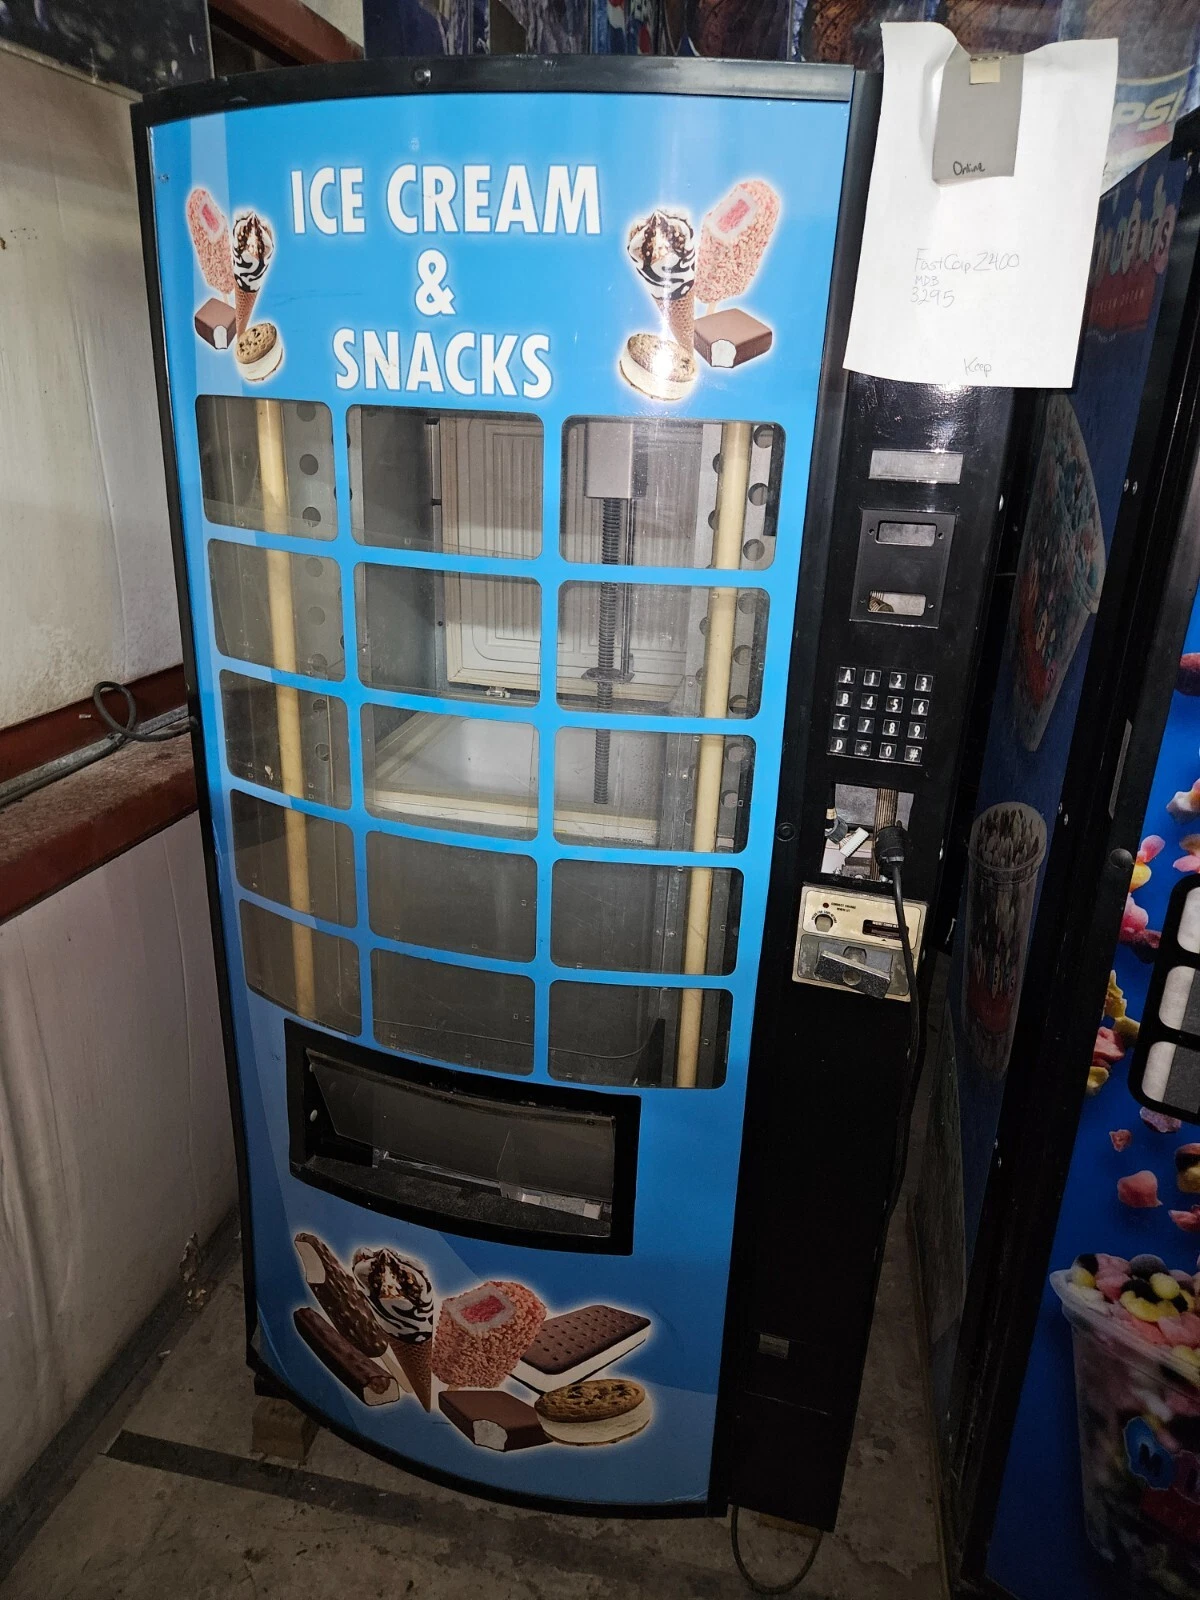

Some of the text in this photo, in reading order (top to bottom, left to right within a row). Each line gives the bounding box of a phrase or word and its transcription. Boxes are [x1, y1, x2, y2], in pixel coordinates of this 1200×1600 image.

[1111, 86, 1187, 138] PSI
[953, 160, 986, 176] Online
[291, 163, 601, 235] ICE CREAM
[414, 247, 456, 316] &
[914, 275, 940, 287] MDB
[909, 286, 955, 308] 3295
[332, 327, 552, 399] SNACKS
[963, 356, 992, 378] Keep
[844, 669, 852, 683] A
[895, 674, 902, 688] 2
[920, 677, 928, 691] 3
[842, 693, 925, 715] B 4 5 6
[839, 716, 921, 737] C 7 8 9
[836, 739, 918, 761] D 0 #
